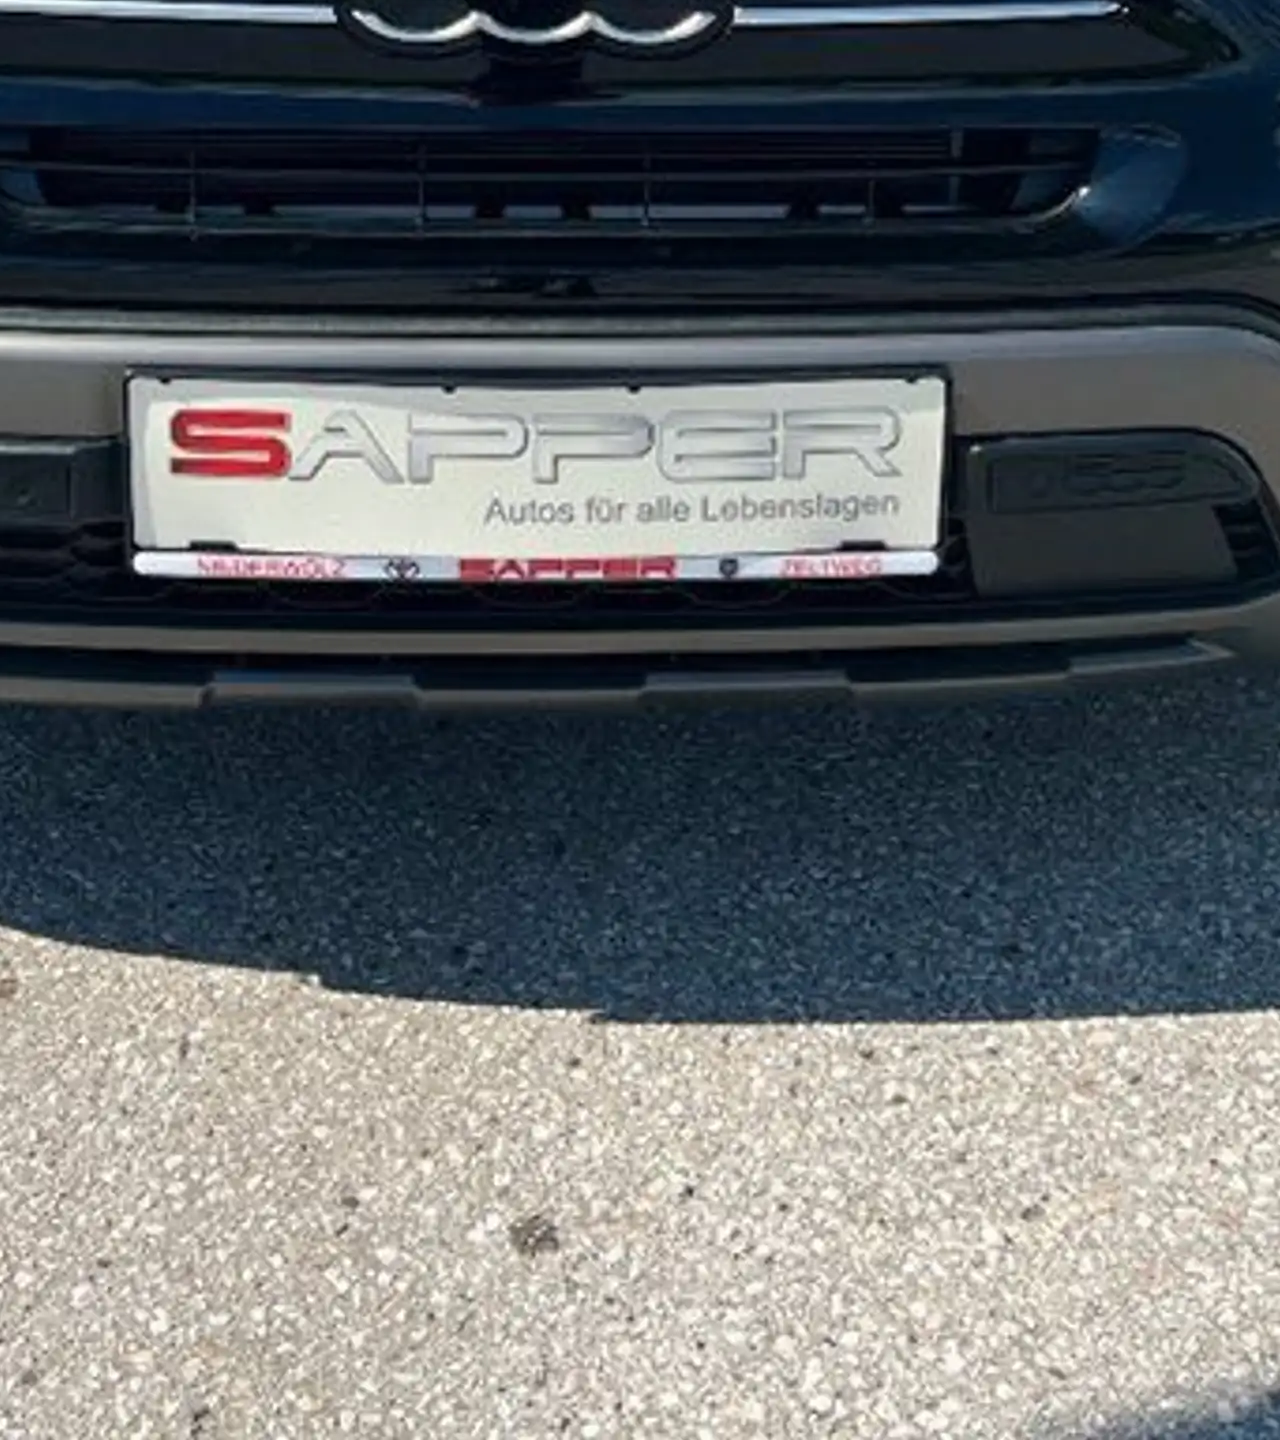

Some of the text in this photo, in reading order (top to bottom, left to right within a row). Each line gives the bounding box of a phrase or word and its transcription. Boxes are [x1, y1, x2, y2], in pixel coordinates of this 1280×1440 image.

[169, 408, 903, 485] SAPPER
[484, 492, 901, 525] Autos für alle Lebenslagen
